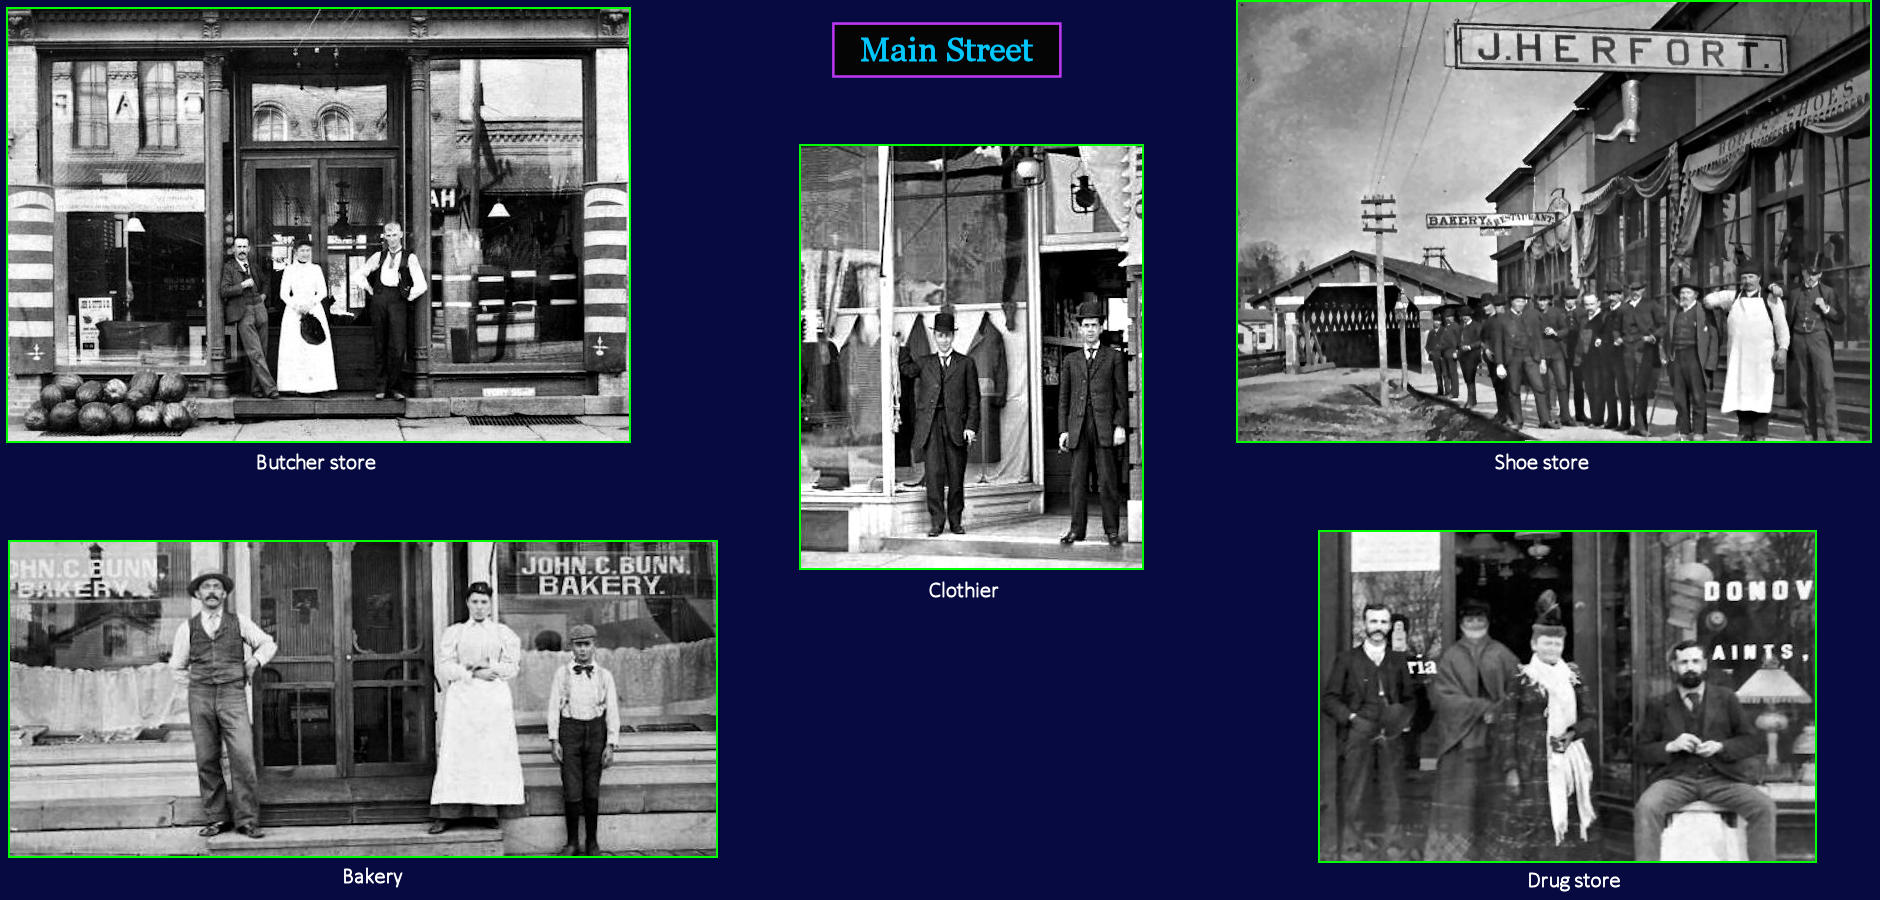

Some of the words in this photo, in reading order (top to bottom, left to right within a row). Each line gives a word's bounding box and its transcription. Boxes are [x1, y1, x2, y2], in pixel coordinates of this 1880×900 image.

[1429, 215, 1487, 226] BAKERY
[539, 575, 665, 596] BAKERY.
[1704, 579, 1814, 602] DONOV
